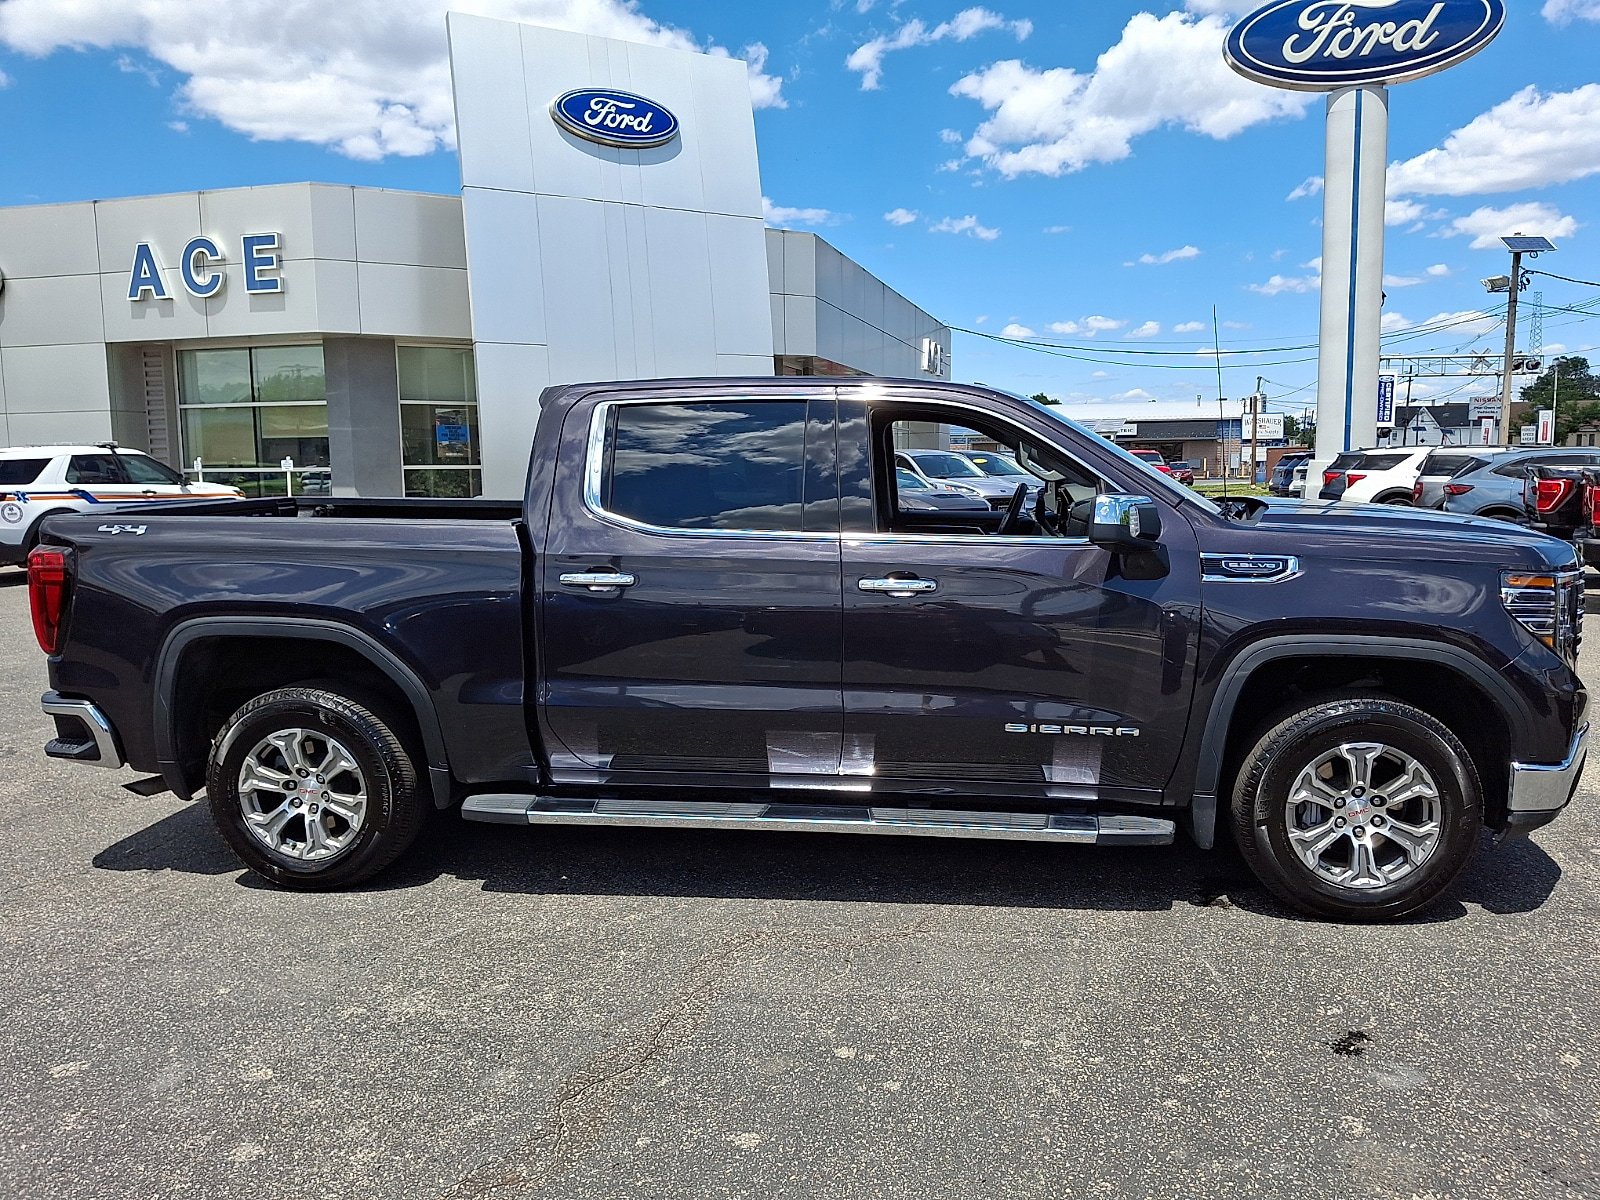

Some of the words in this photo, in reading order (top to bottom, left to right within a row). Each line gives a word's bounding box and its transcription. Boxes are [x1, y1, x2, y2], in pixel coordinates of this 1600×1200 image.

[1282, 0, 1445, 64] Ford
[583, 97, 654, 133] Ford
[127, 231, 285, 302] ACE
[1384, 382, 1392, 421] CERTIFIED
[1004, 722, 1140, 738] SIERRA
[1348, 807, 1370, 817] GMC
